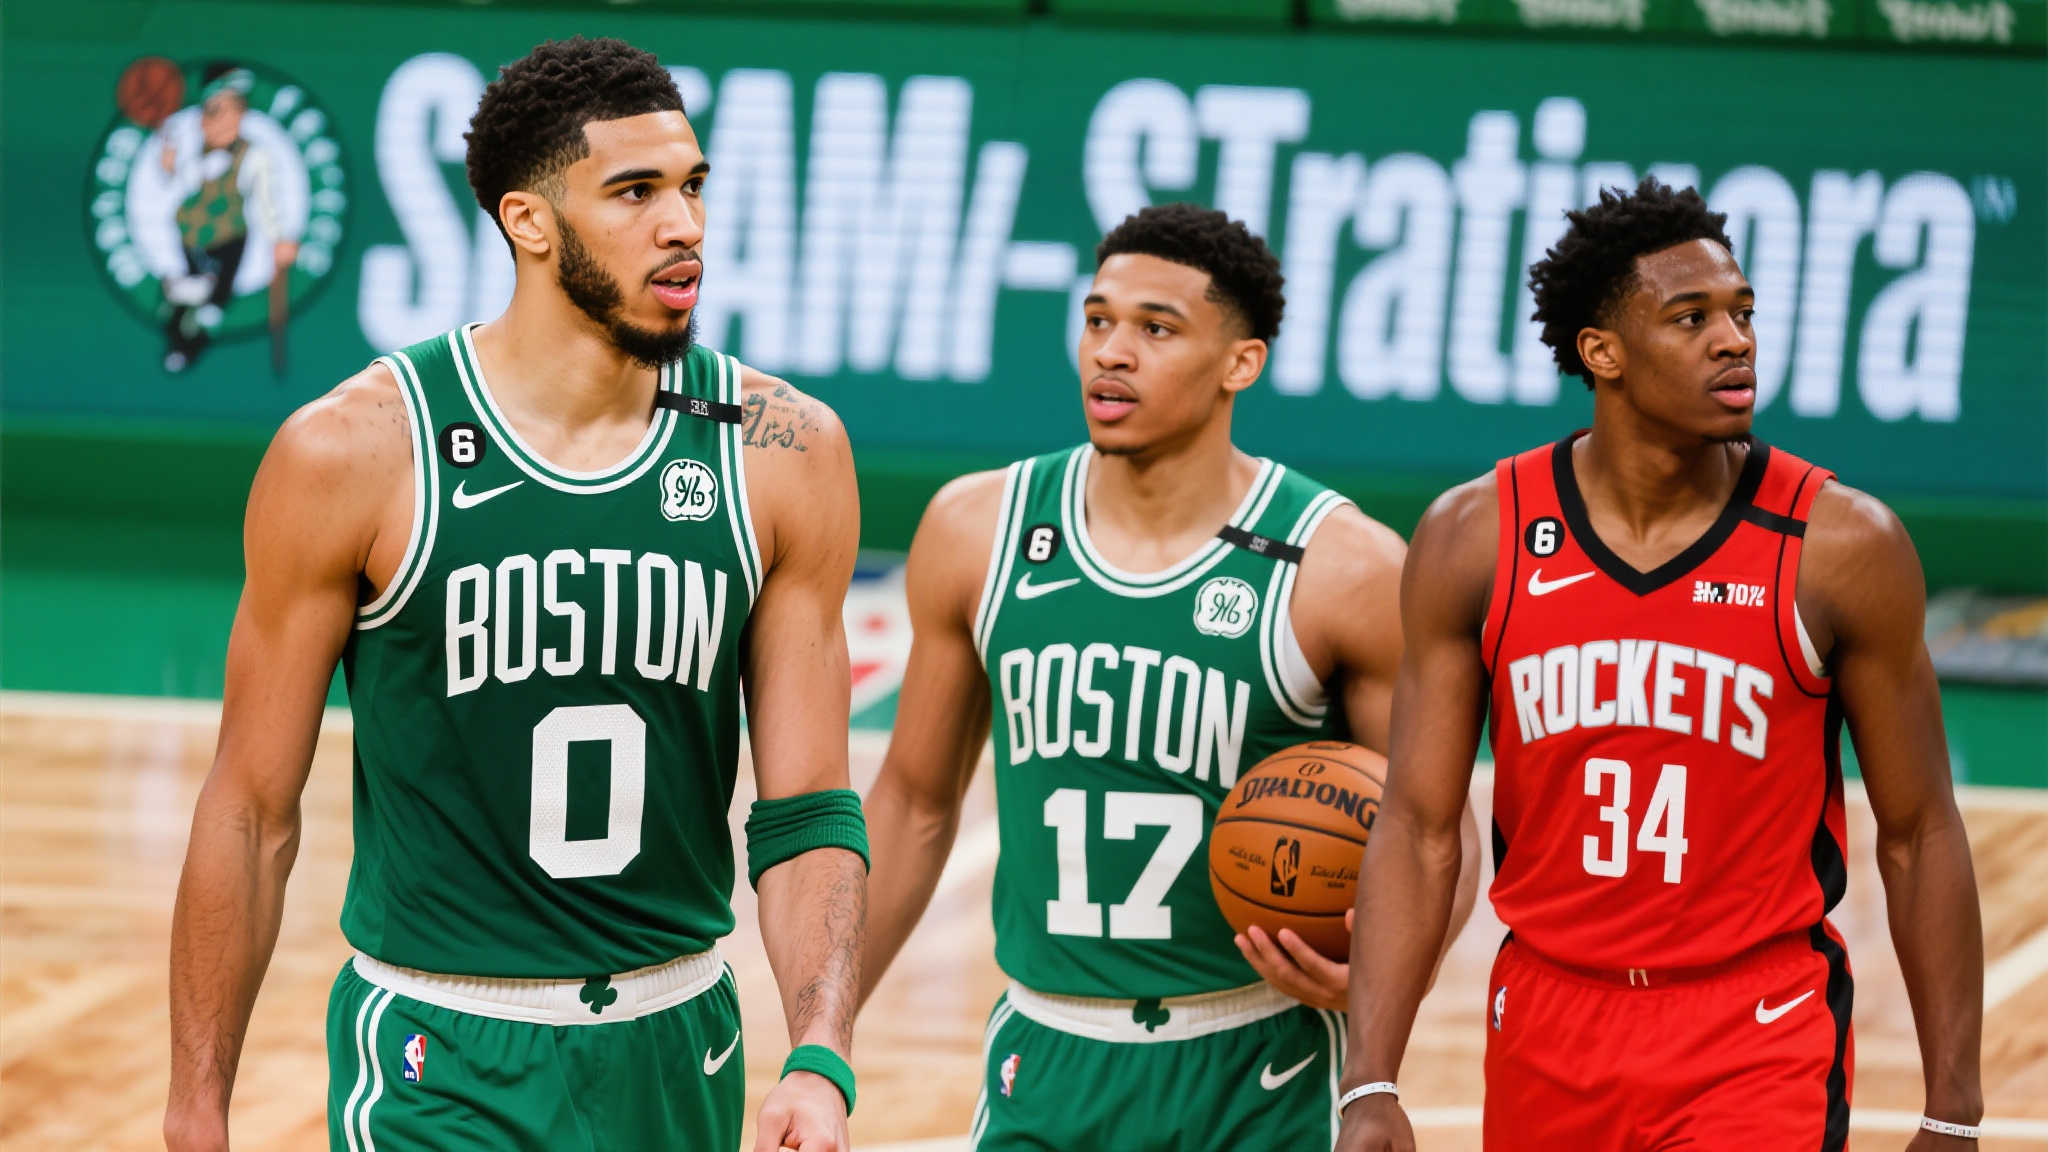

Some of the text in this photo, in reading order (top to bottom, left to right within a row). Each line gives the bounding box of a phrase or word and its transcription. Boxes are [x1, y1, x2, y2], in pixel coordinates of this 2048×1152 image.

[451, 428, 475, 463] 6
[1028, 527, 1054, 561] 6
[1534, 521, 1556, 555] 6
[446, 548, 728, 698] BOSTON
[999, 642, 1251, 790] BOSTON
[1508, 638, 1774, 761] ROCKETS
[529, 703, 647, 879] 0
[1582, 757, 1689, 885] 34
[1043, 787, 1204, 940] 17
